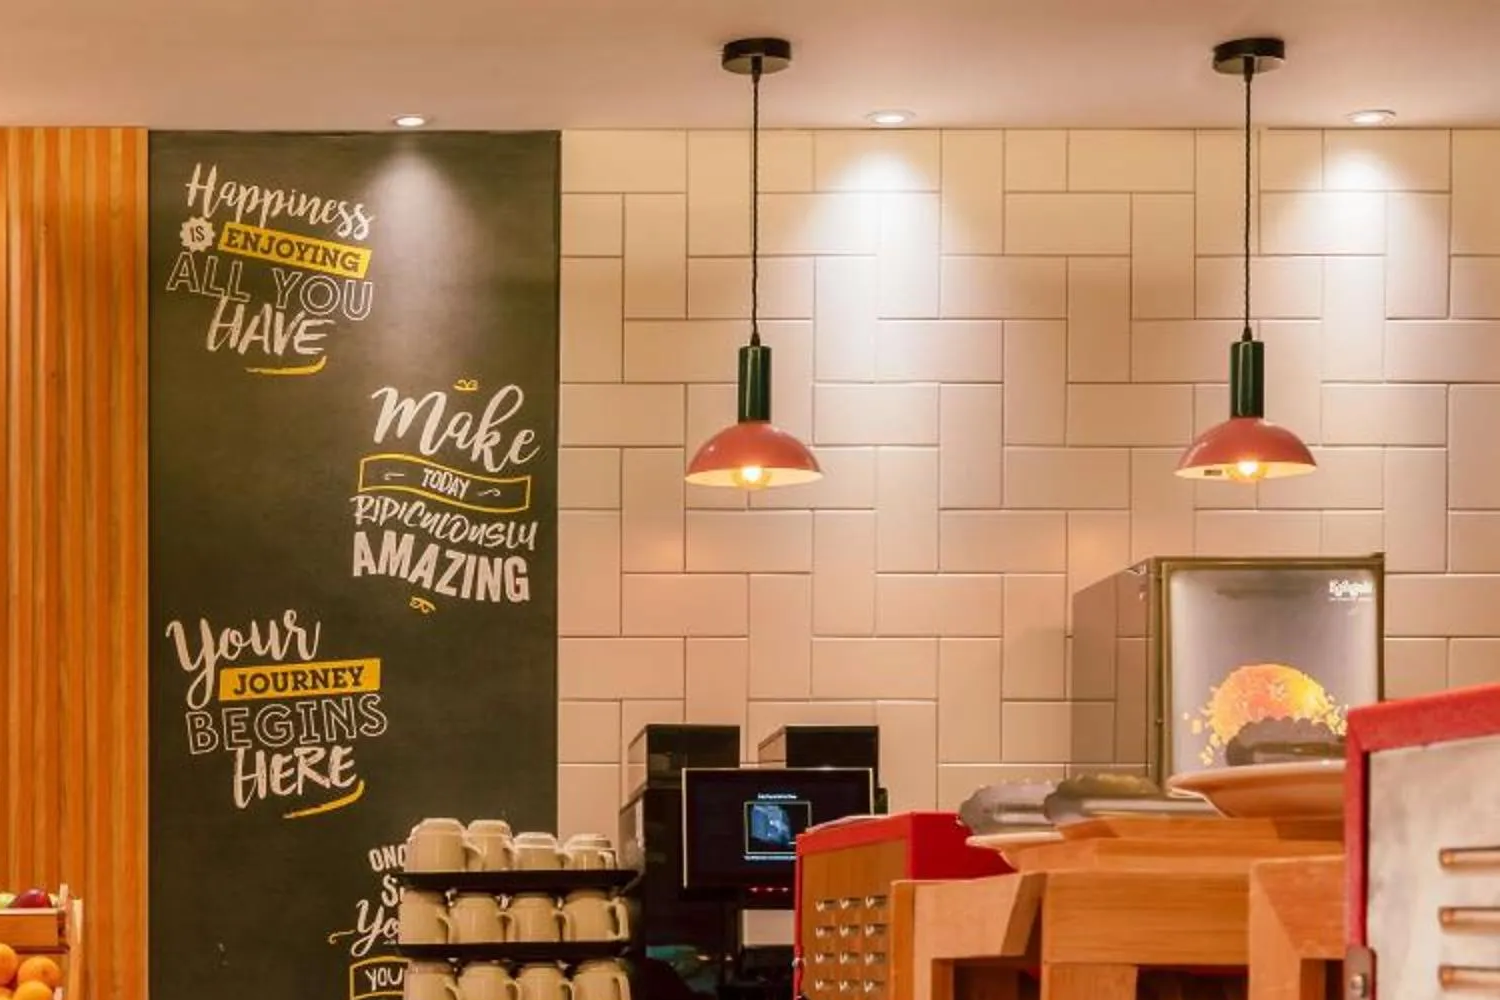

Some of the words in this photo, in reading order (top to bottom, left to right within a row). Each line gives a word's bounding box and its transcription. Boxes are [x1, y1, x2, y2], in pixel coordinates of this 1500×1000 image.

[186, 162, 377, 241] Happiness
[188, 225, 206, 244] IS
[224, 225, 362, 275] ENJOYING
[166, 251, 251, 304] ALL
[272, 266, 373, 321] YOU
[206, 294, 336, 357] HAVE
[372, 384, 541, 473] Make
[421, 467, 471, 500] TODAY
[353, 529, 531, 602] AMAZING
[165, 609, 321, 710] Your
[233, 665, 365, 695] JOURNEY
[185, 693, 388, 755] BEGINS
[233, 745, 357, 809] HERE
